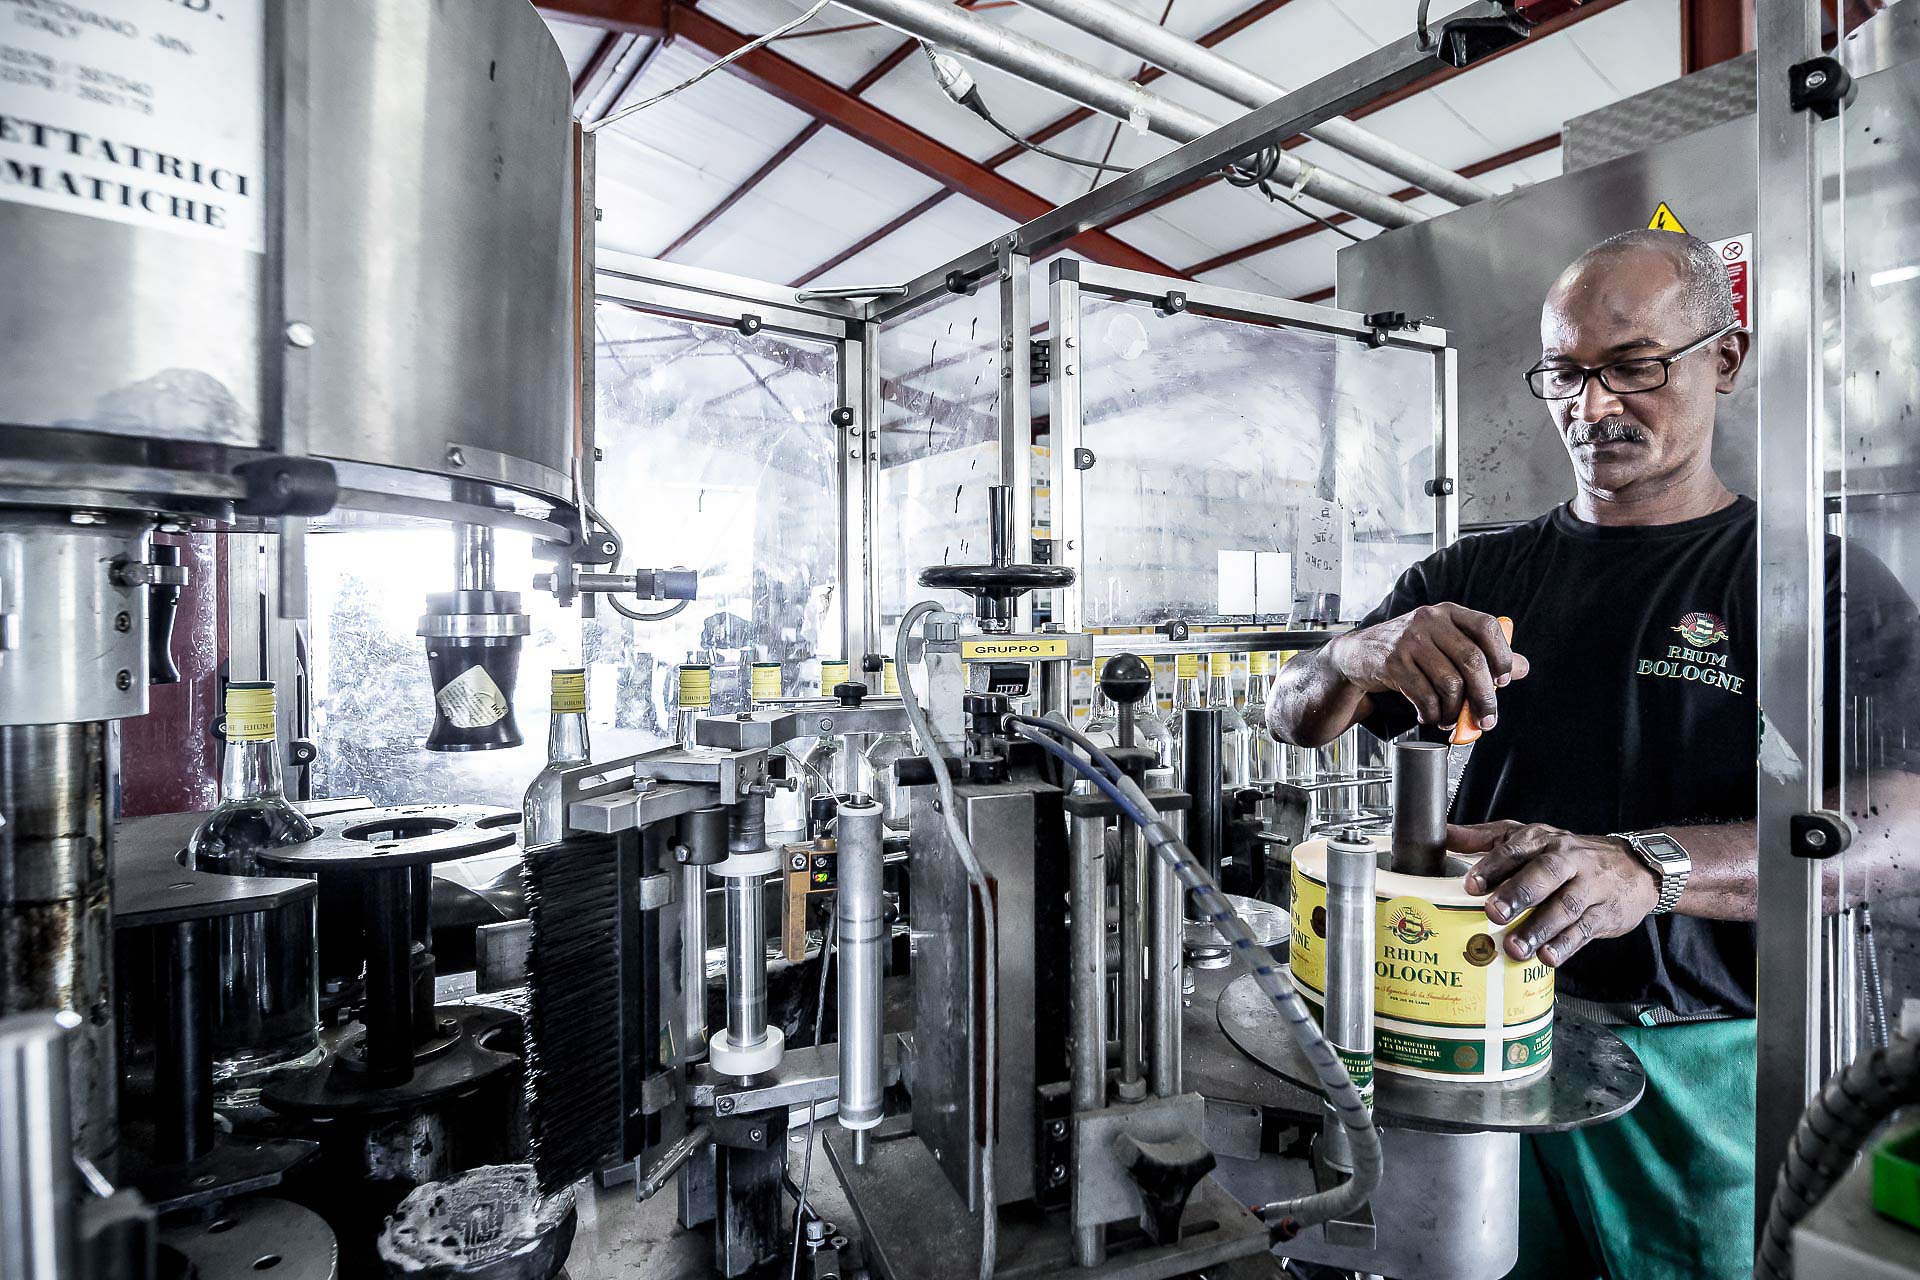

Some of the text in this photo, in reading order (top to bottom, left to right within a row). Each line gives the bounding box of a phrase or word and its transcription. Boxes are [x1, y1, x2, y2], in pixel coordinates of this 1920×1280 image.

[2, 158, 227, 230] MATICHE
[975, 645, 1040, 654] GRUPPO
[1667, 645, 1728, 668] RHUM
[1636, 659, 1745, 695] BOLOGNE
[1384, 945, 1438, 966] RHUM
[1375, 961, 1463, 988] OLOGNE
